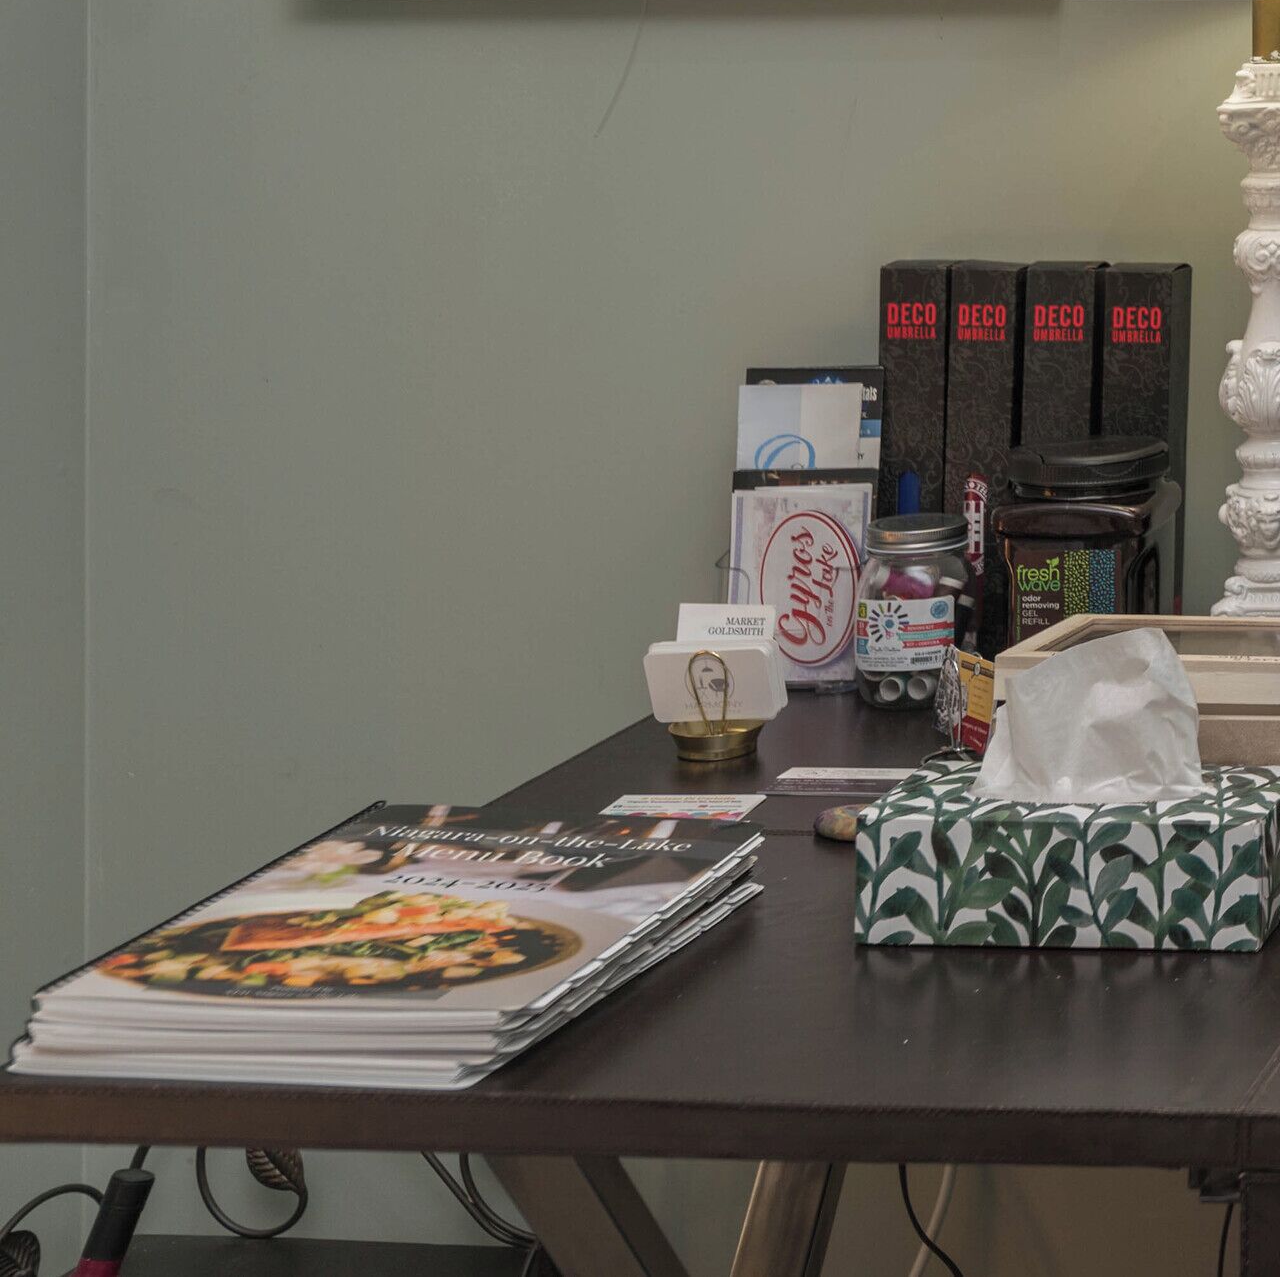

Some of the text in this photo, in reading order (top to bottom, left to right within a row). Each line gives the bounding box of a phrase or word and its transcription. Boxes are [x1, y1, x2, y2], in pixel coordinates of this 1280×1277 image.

[888, 303, 936, 325] DECO
[959, 305, 1006, 326] DECO
[1034, 305, 1084, 327] DECO
[1112, 307, 1161, 329] DECO
[887, 327, 936, 339] UMBRELLA
[958, 327, 1006, 341] UMBRELLA
[1033, 329, 1084, 341] UMBRELLA
[1112, 330, 1161, 343] UMBRELLA
[1017, 565, 1059, 581] fresh
[779, 526, 826, 646] Gyros
[1018, 580, 1060, 591] wave
[726, 617, 766, 626] MARKET
[708, 627, 764, 636] GOLDSMITH
[365, 826, 692, 852] Niagara-on-the-Lake
[392, 843, 614, 868] Menu Book
[383, 875, 551, 892] 2024-2025
